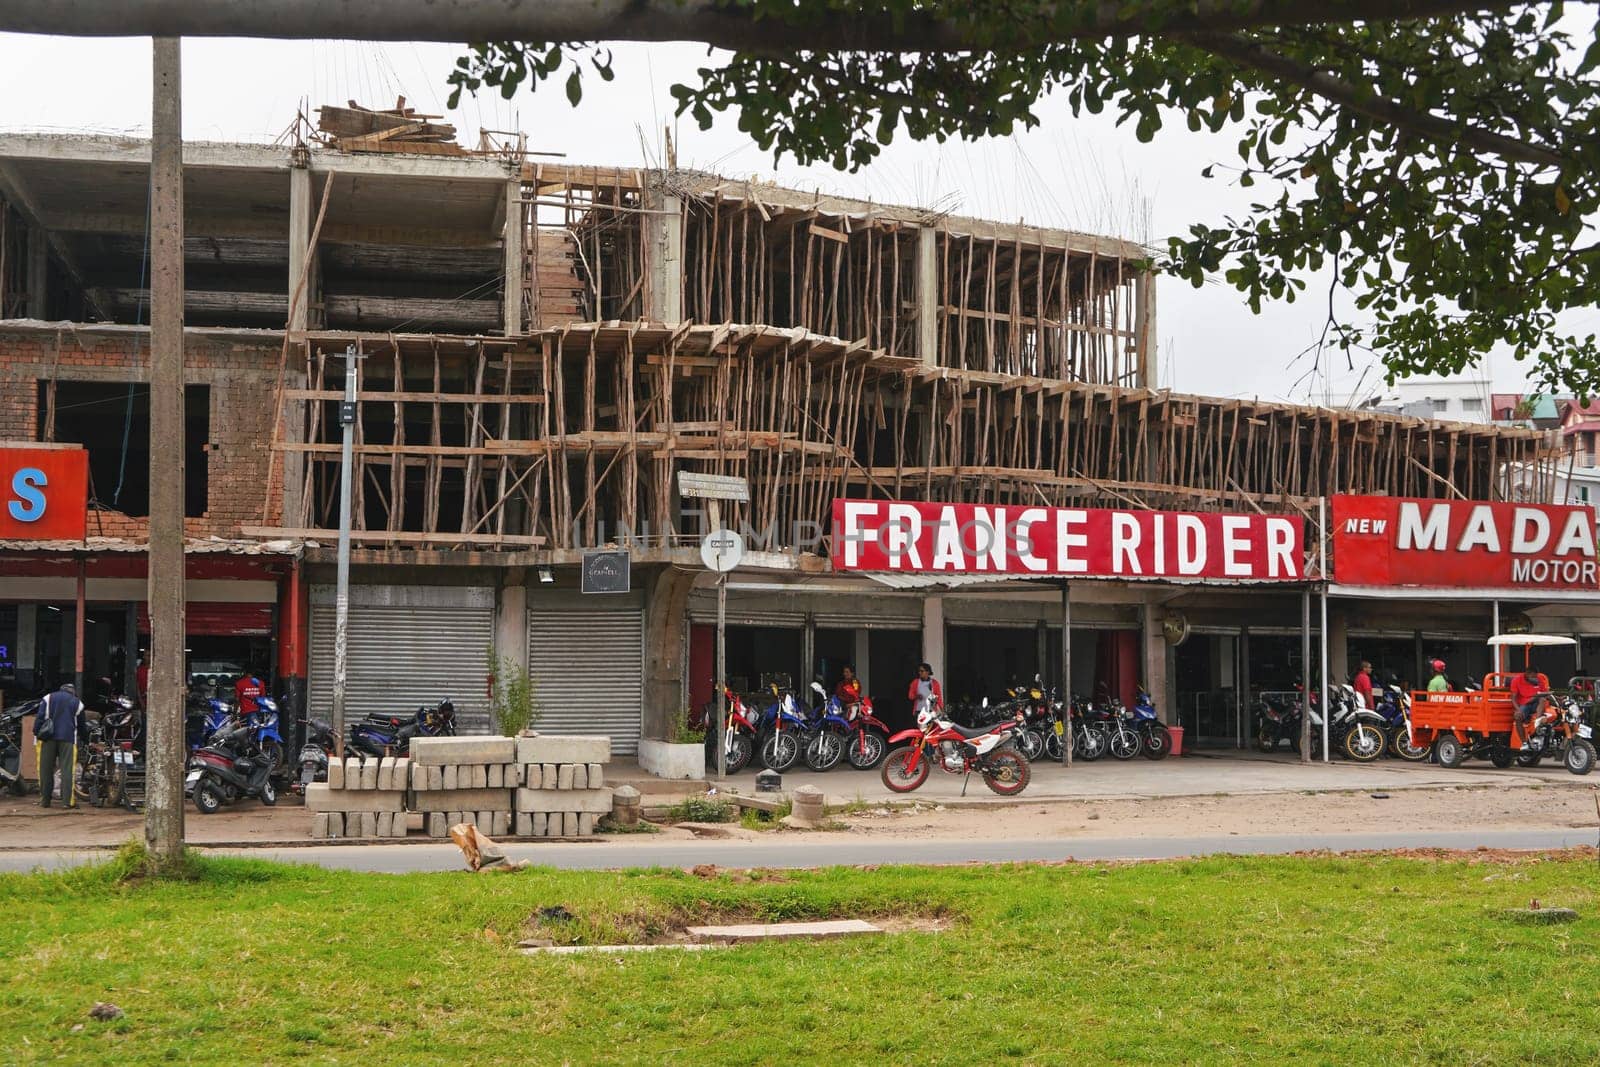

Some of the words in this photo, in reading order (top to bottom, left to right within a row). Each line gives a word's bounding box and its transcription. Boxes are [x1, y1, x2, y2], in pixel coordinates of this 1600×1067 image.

[8, 467, 48, 522] S
[844, 502, 1088, 572] FRANCE
[1112, 511, 1298, 577] RIDER
[1346, 518, 1388, 535] NEW
[1397, 502, 1596, 556] MADA
[1511, 559, 1596, 585] MOTOR
[1430, 695, 1445, 703] NEW
[1445, 695, 1464, 704] MADA
